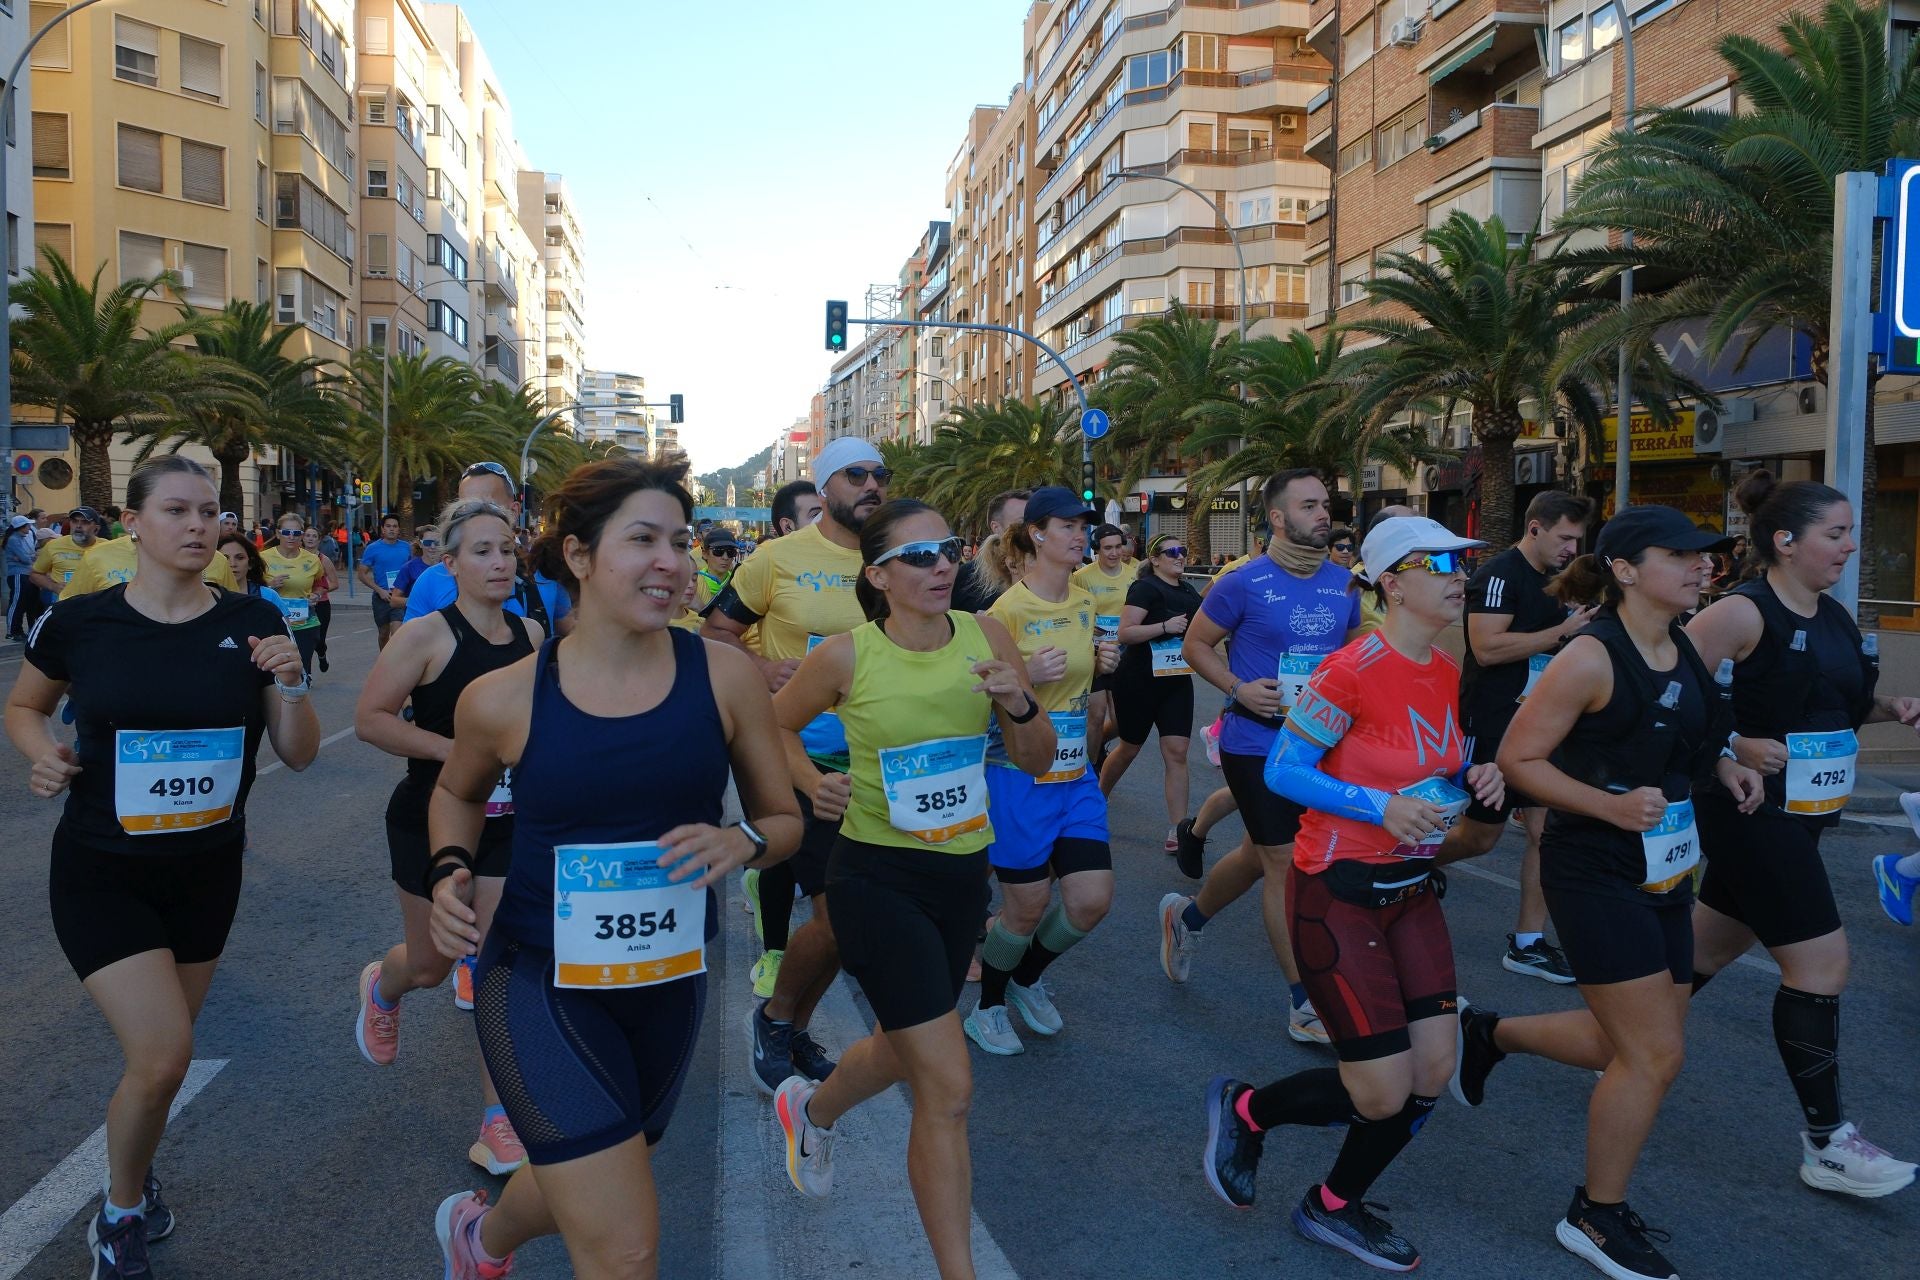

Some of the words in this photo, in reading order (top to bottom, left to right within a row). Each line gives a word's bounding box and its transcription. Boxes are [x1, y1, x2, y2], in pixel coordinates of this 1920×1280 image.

[152, 741, 172, 754] VI
[1814, 741, 1827, 753] VI
[911, 754, 929, 769] VI
[1811, 769, 1846, 786] 4792
[149, 776, 215, 797] 4910
[915, 785, 967, 813] 3853
[1665, 813, 1678, 825] VI
[1665, 840, 1692, 864] 4791
[598, 860, 623, 880] VI
[636, 876, 659, 887] 2025
[594, 908, 677, 940] 3854
[627, 943, 651, 952] Anisa
[1819, 1158, 1846, 1173] HOKA
[1578, 1217, 1607, 1248] HOKA
